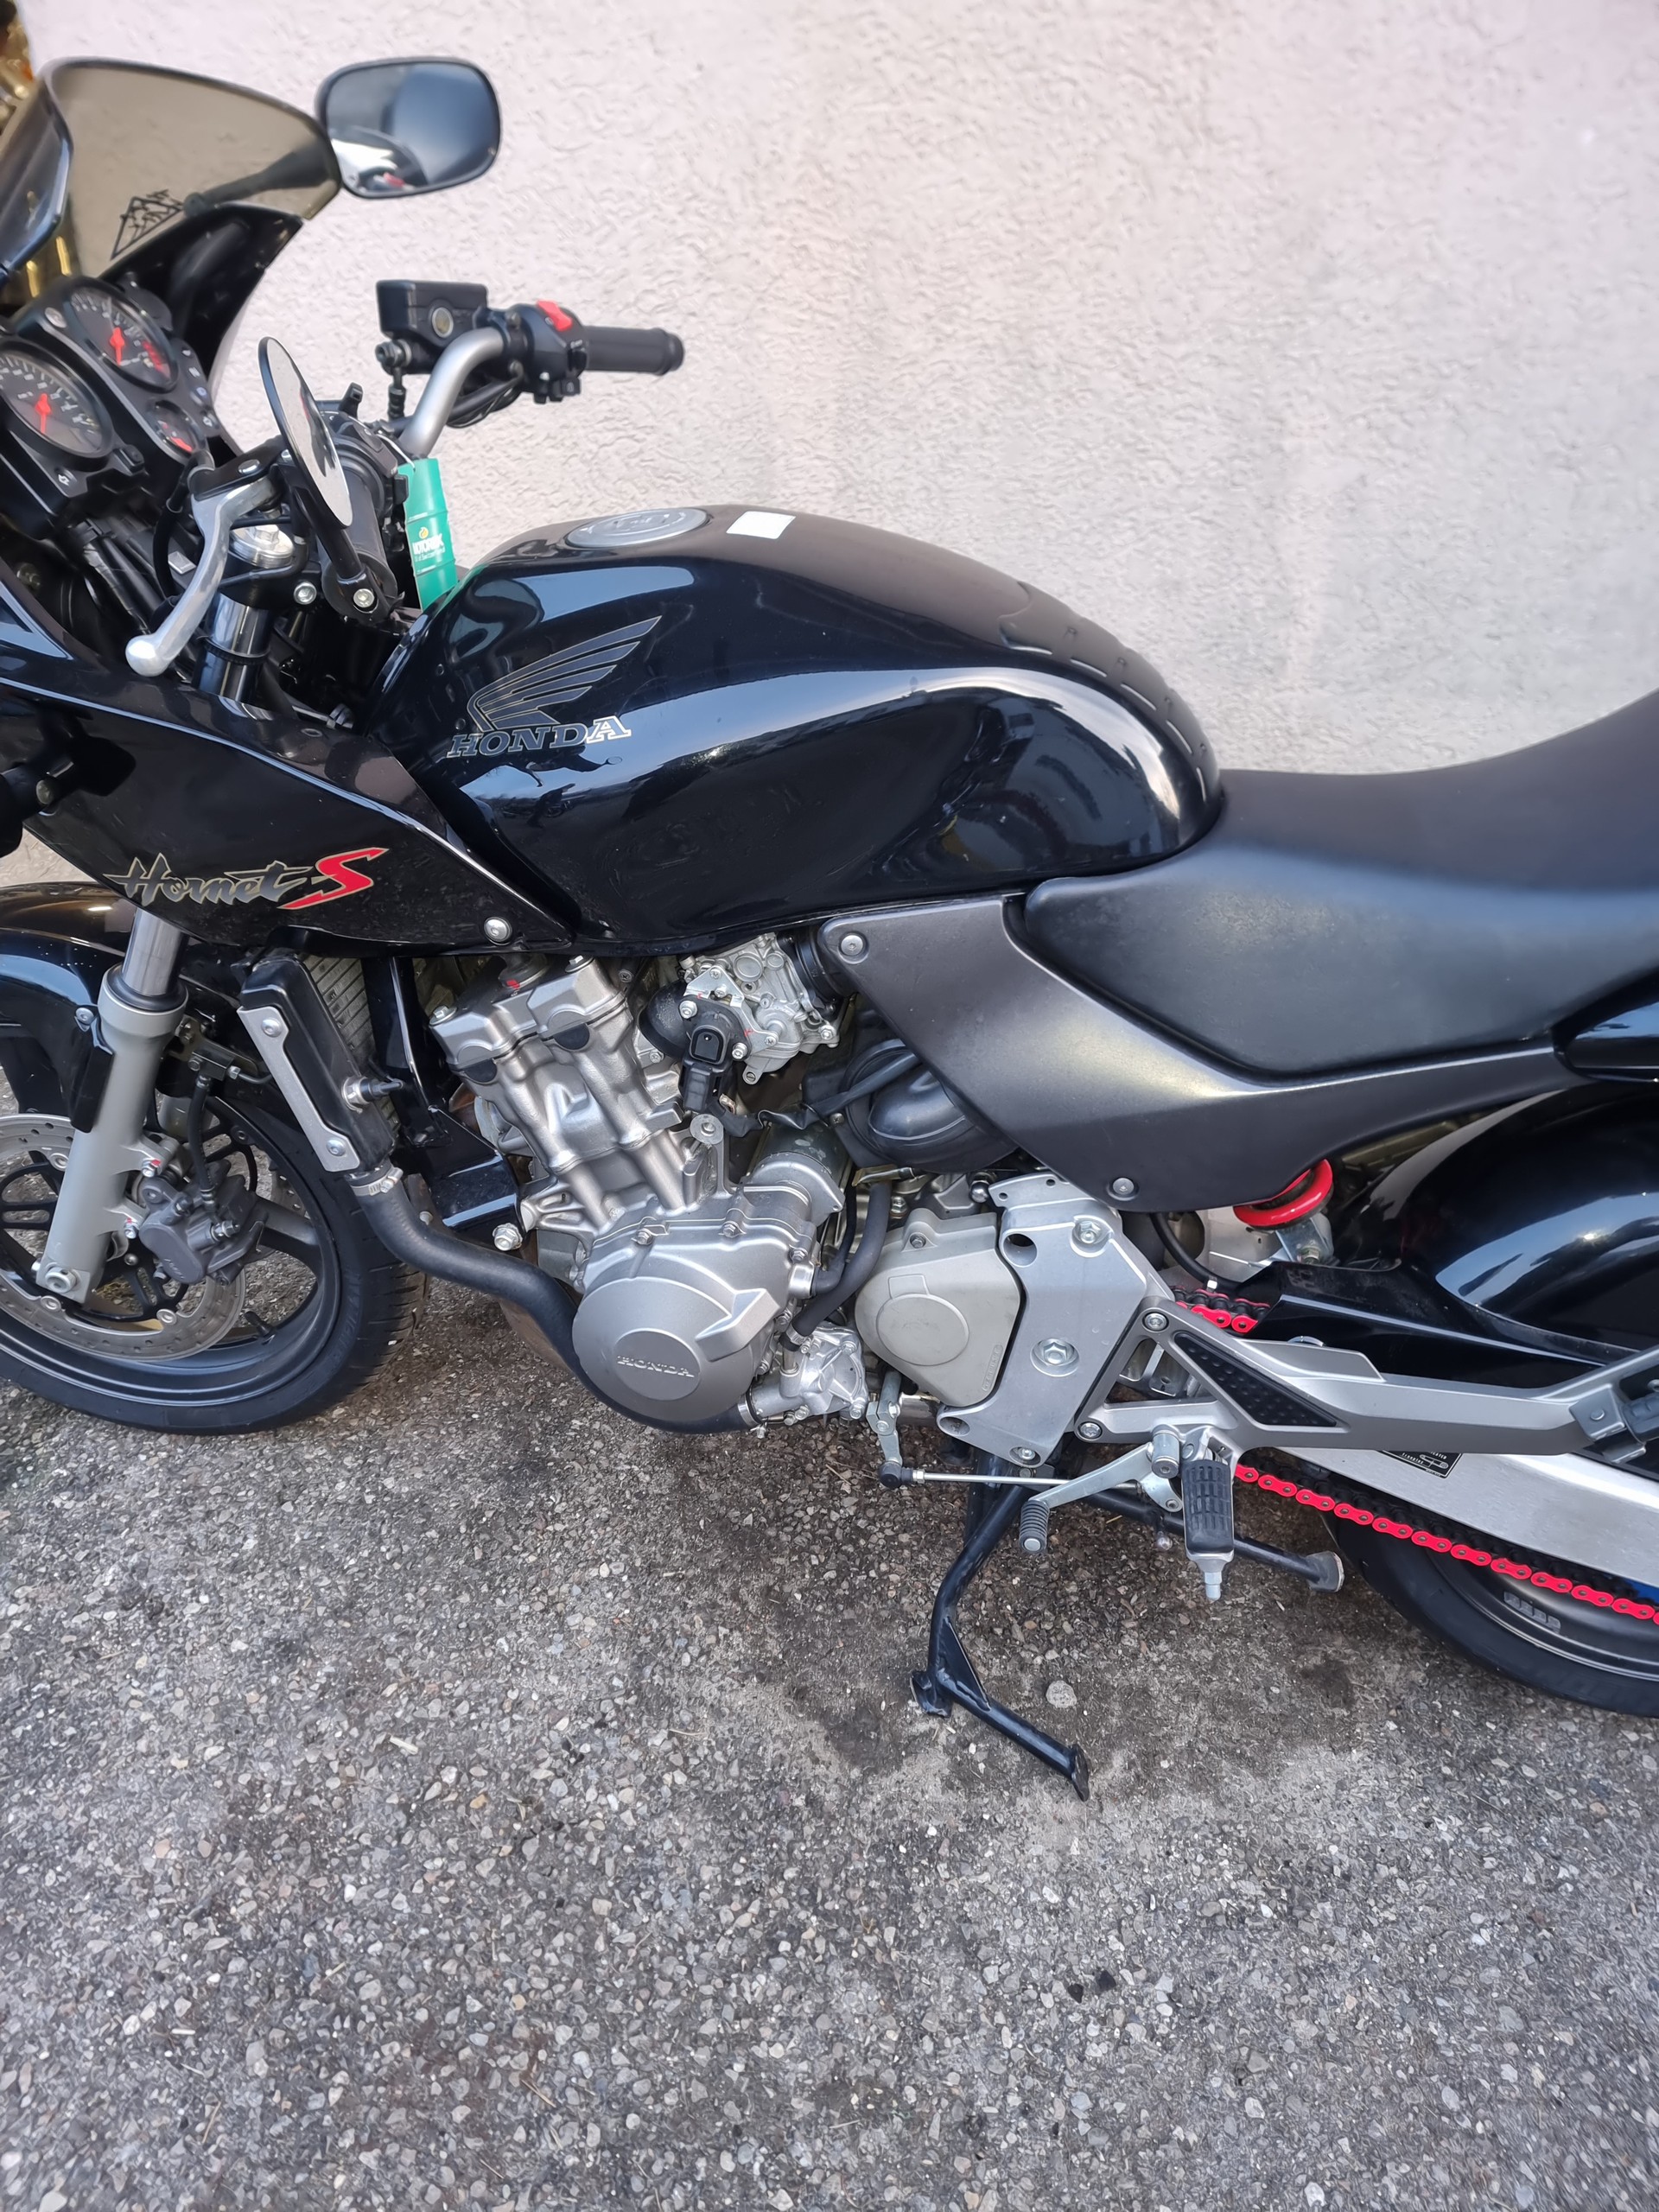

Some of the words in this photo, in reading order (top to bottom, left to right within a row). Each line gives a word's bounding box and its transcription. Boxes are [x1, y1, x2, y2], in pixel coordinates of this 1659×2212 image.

[447, 715, 632, 758] HONDA
[103, 853, 312, 906] Hornet
[276, 847, 389, 910] S
[616, 1355, 696, 1378] HONDA
